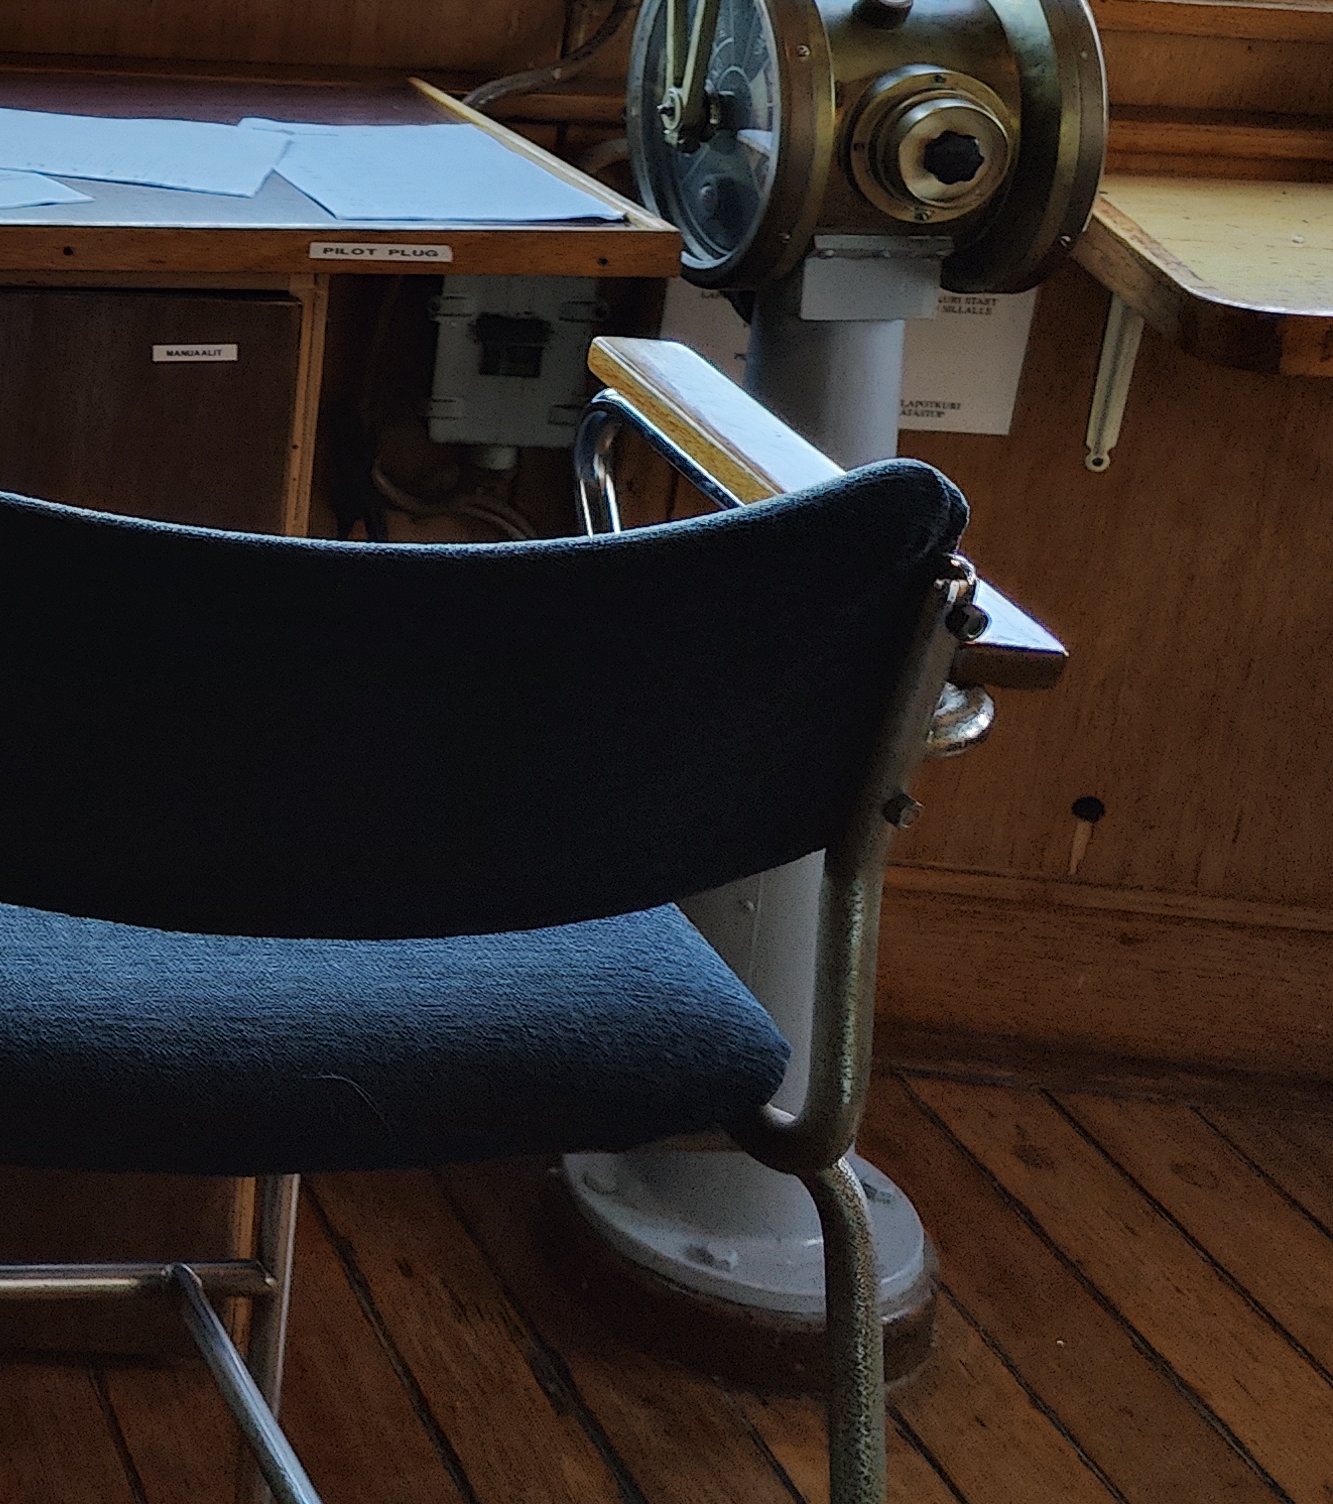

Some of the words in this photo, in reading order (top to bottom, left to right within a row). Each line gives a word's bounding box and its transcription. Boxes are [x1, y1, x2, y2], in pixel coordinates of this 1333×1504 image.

[322, 246, 378, 256] PILOT
[389, 248, 439, 258] PLUG
[166, 349, 223, 357] MANUAALIT
[900, 399, 962, 410] LAPOTKURI
